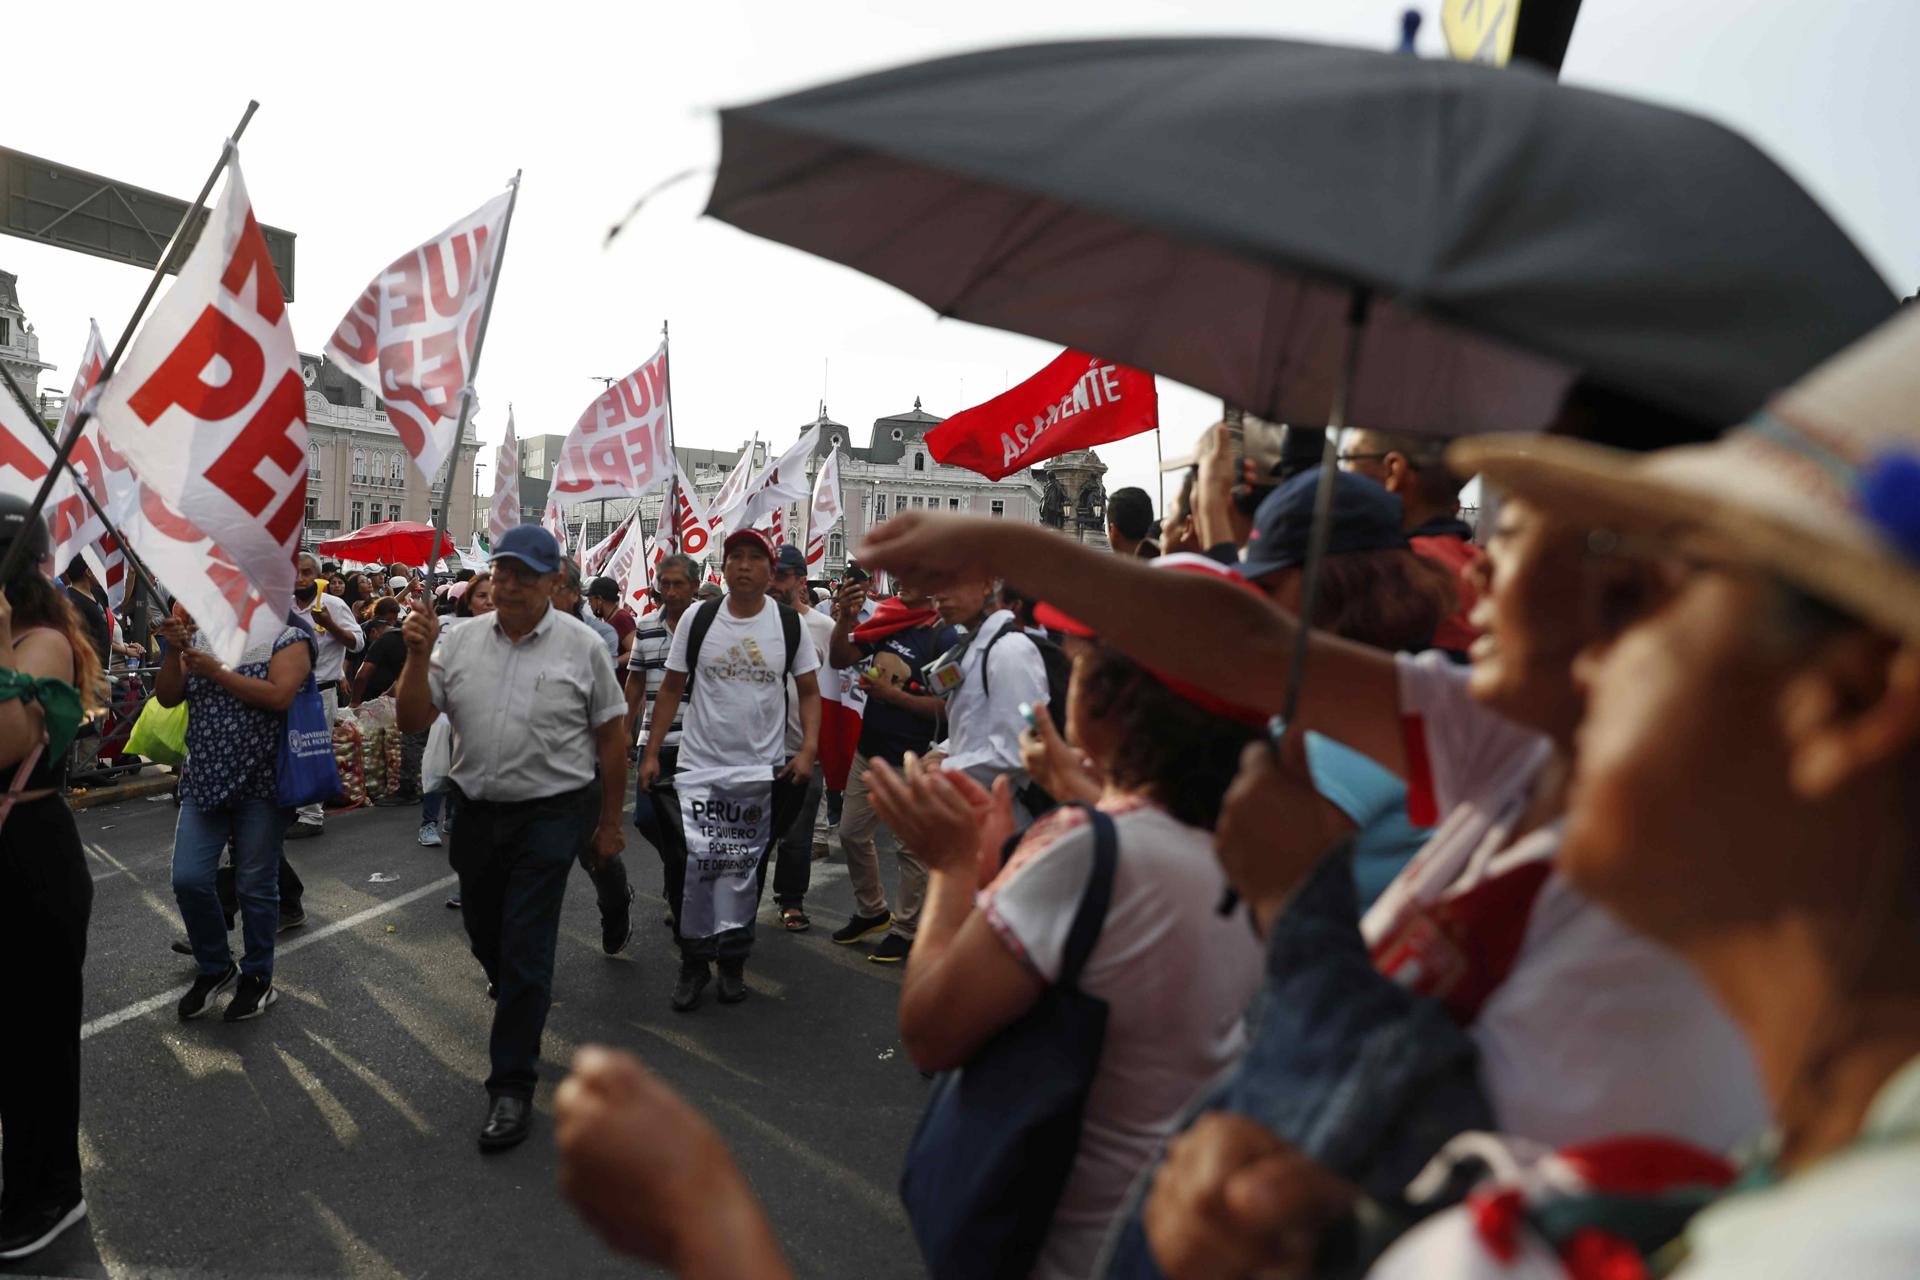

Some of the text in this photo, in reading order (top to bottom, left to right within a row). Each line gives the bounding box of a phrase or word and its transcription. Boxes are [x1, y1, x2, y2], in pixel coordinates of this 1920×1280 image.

[704, 662, 776, 683] adidas
[691, 799, 740, 822] PERÚ
[699, 826, 757, 839] TE QUIERO
[709, 842, 749, 855] POR ESO
[696, 859, 709, 871] TE
